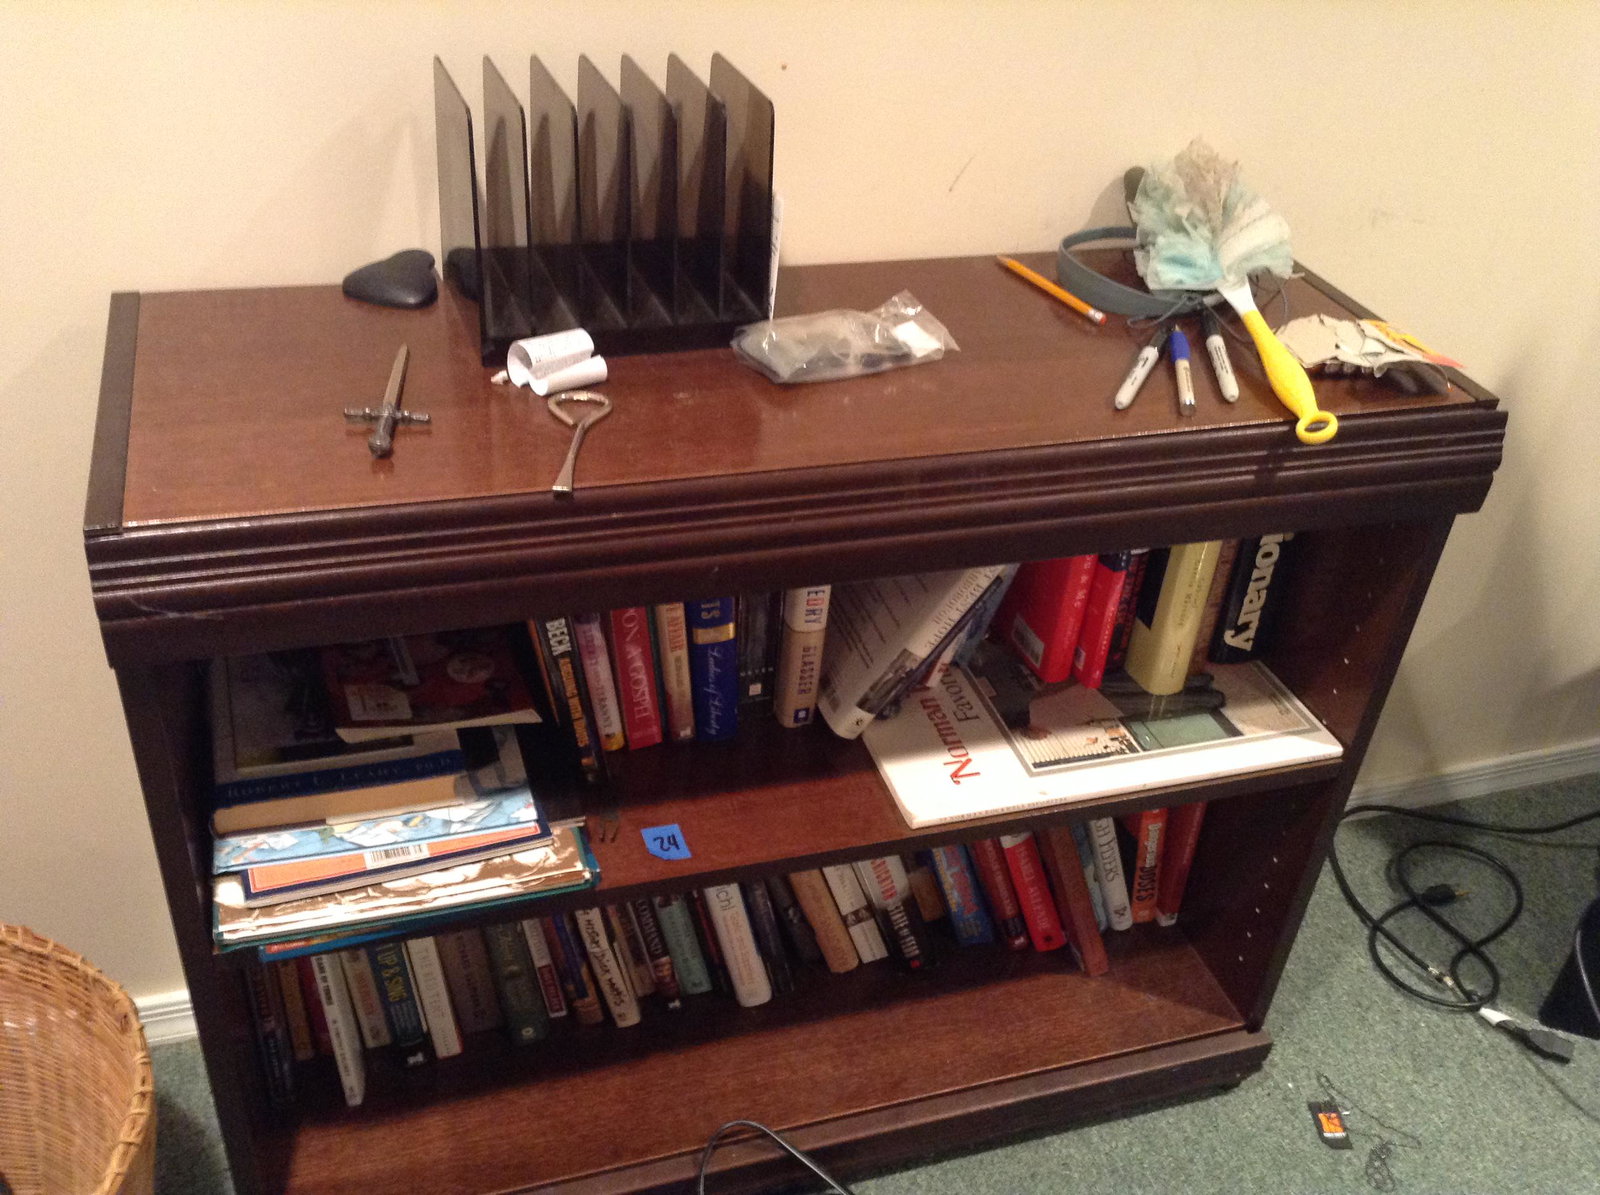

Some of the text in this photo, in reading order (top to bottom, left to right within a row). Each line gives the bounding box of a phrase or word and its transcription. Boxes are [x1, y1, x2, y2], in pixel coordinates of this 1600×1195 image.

[544, 616, 573, 655] BECK
[625, 662, 654, 721] GOSPEL
[920, 697, 981, 785] Norman
[653, 834, 680, 851] 24
[1135, 862, 1158, 903] DOSES
